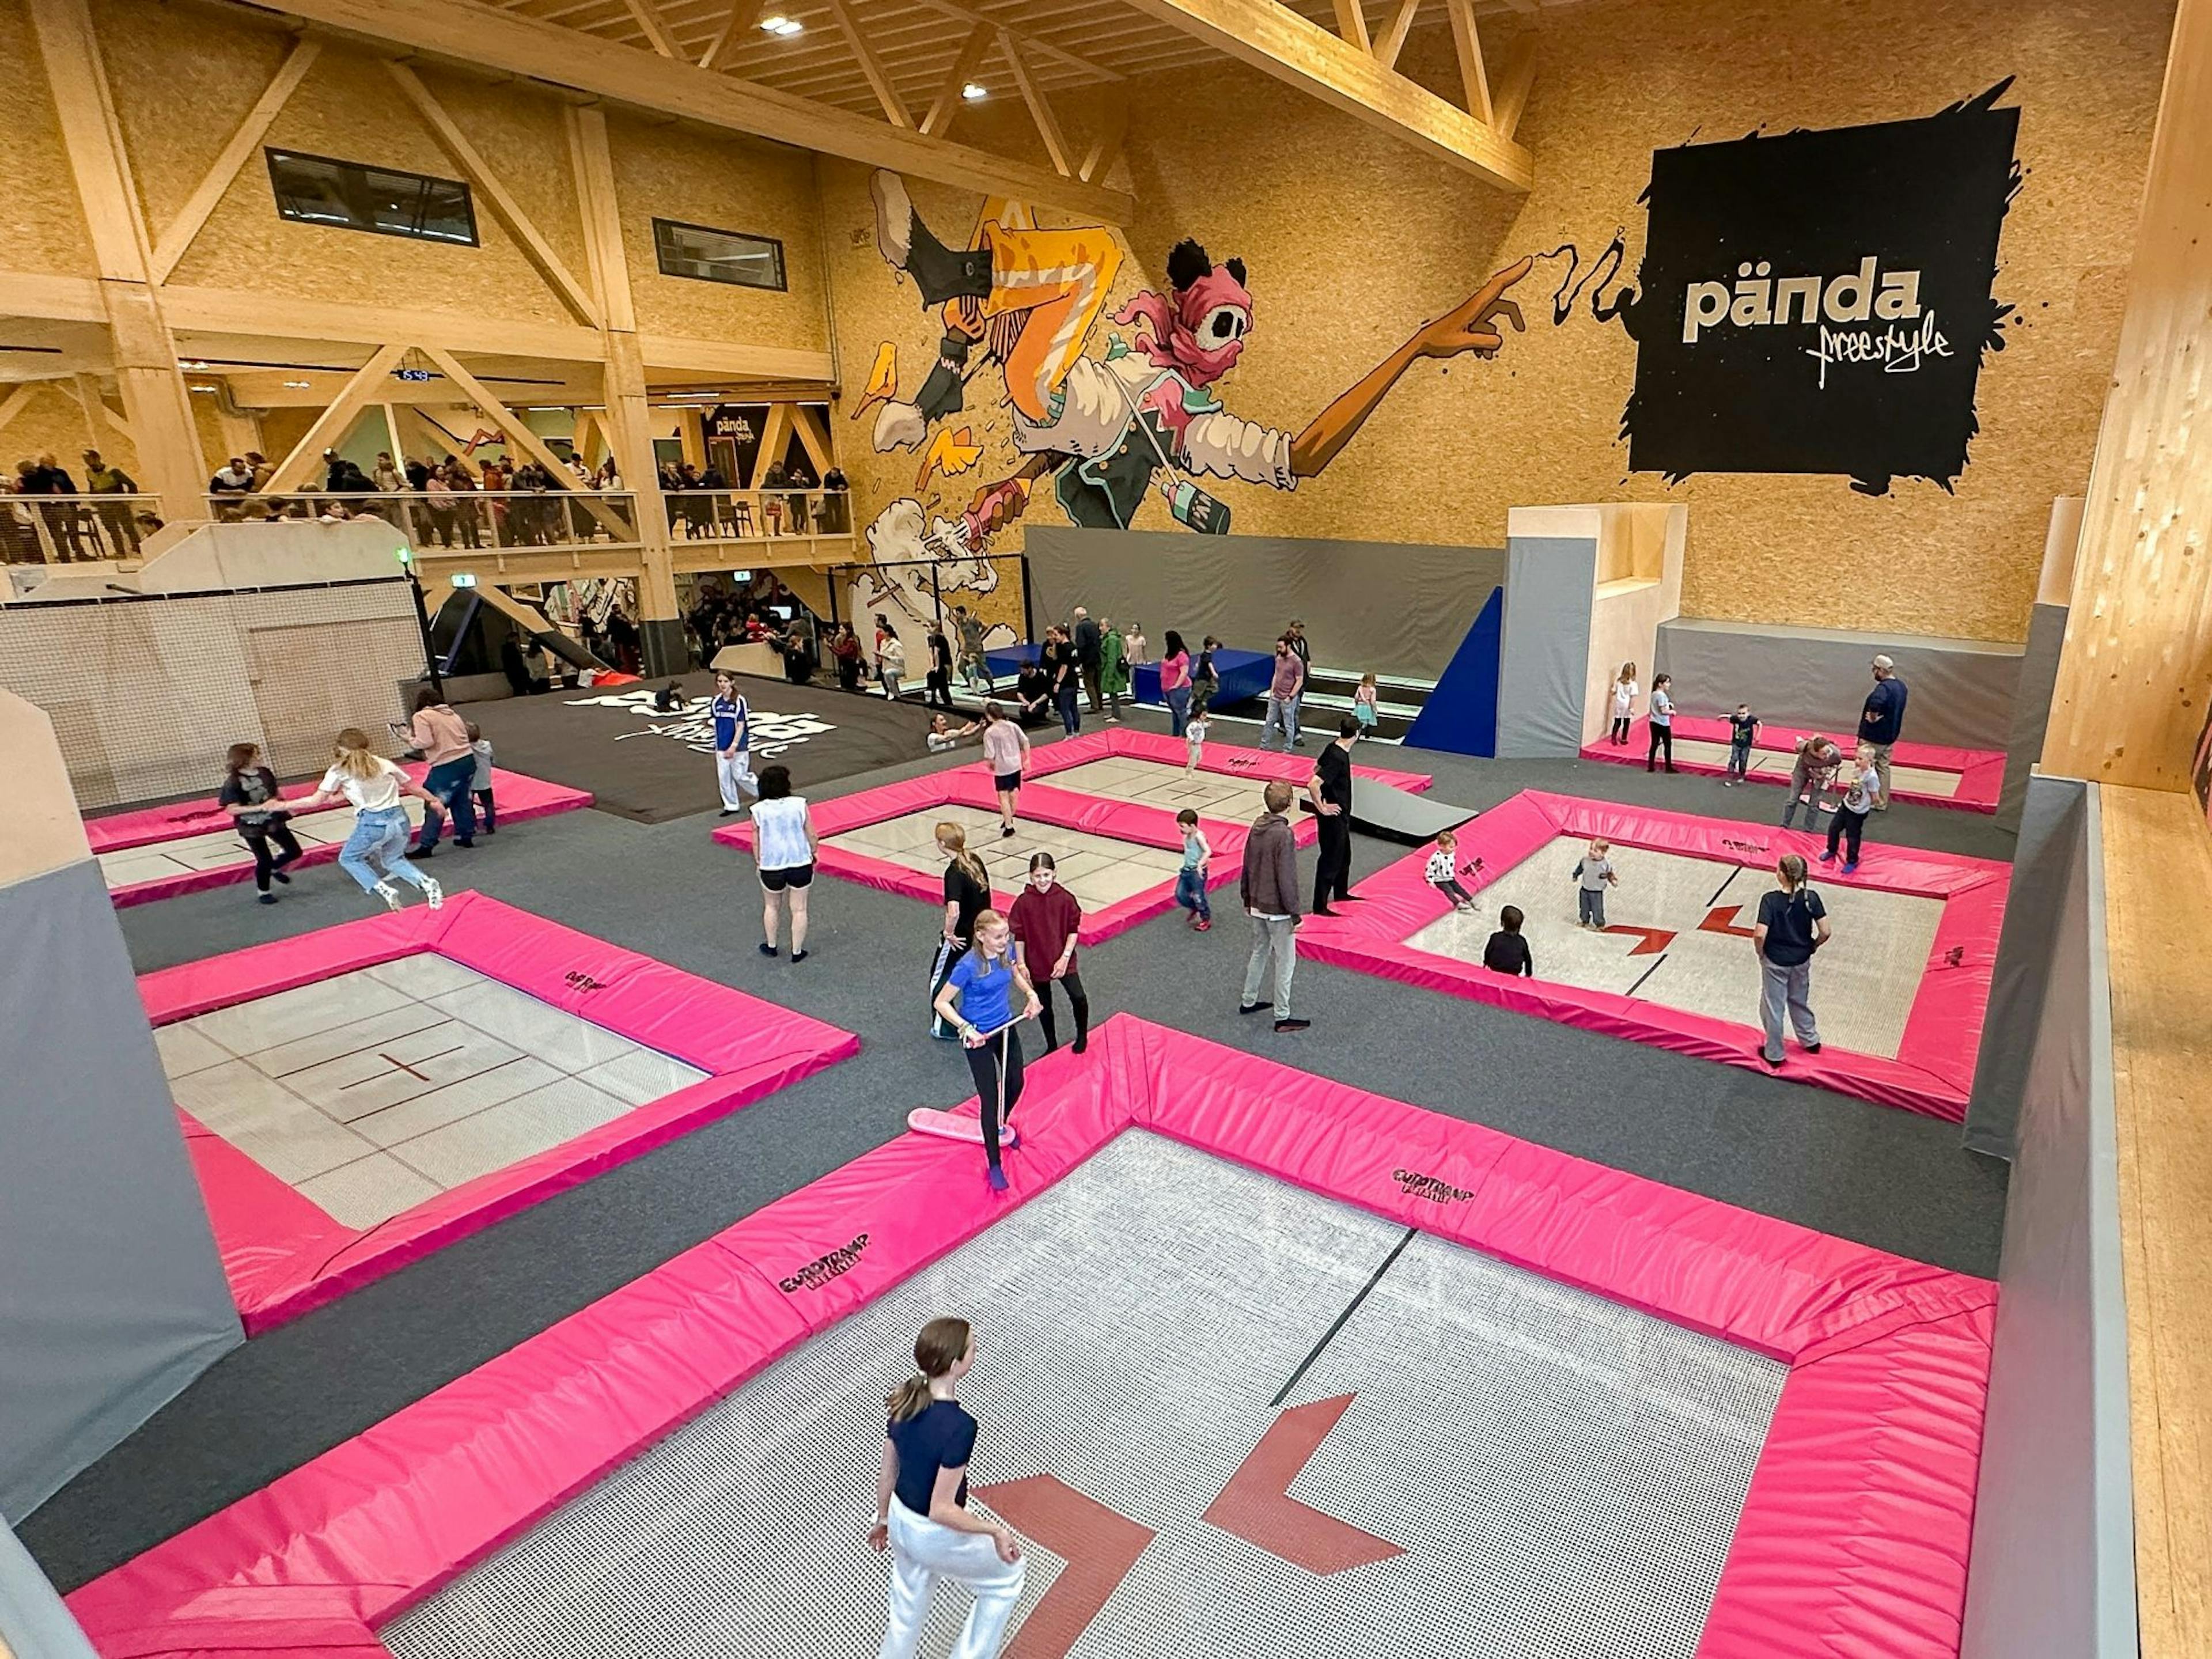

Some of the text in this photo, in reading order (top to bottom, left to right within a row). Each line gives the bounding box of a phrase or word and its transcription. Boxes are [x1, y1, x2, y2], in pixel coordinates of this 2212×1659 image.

[1682, 256, 1921, 343] pända
[716, 415, 749, 435] pända
[779, 1234, 869, 1293] EUROTRAMP
